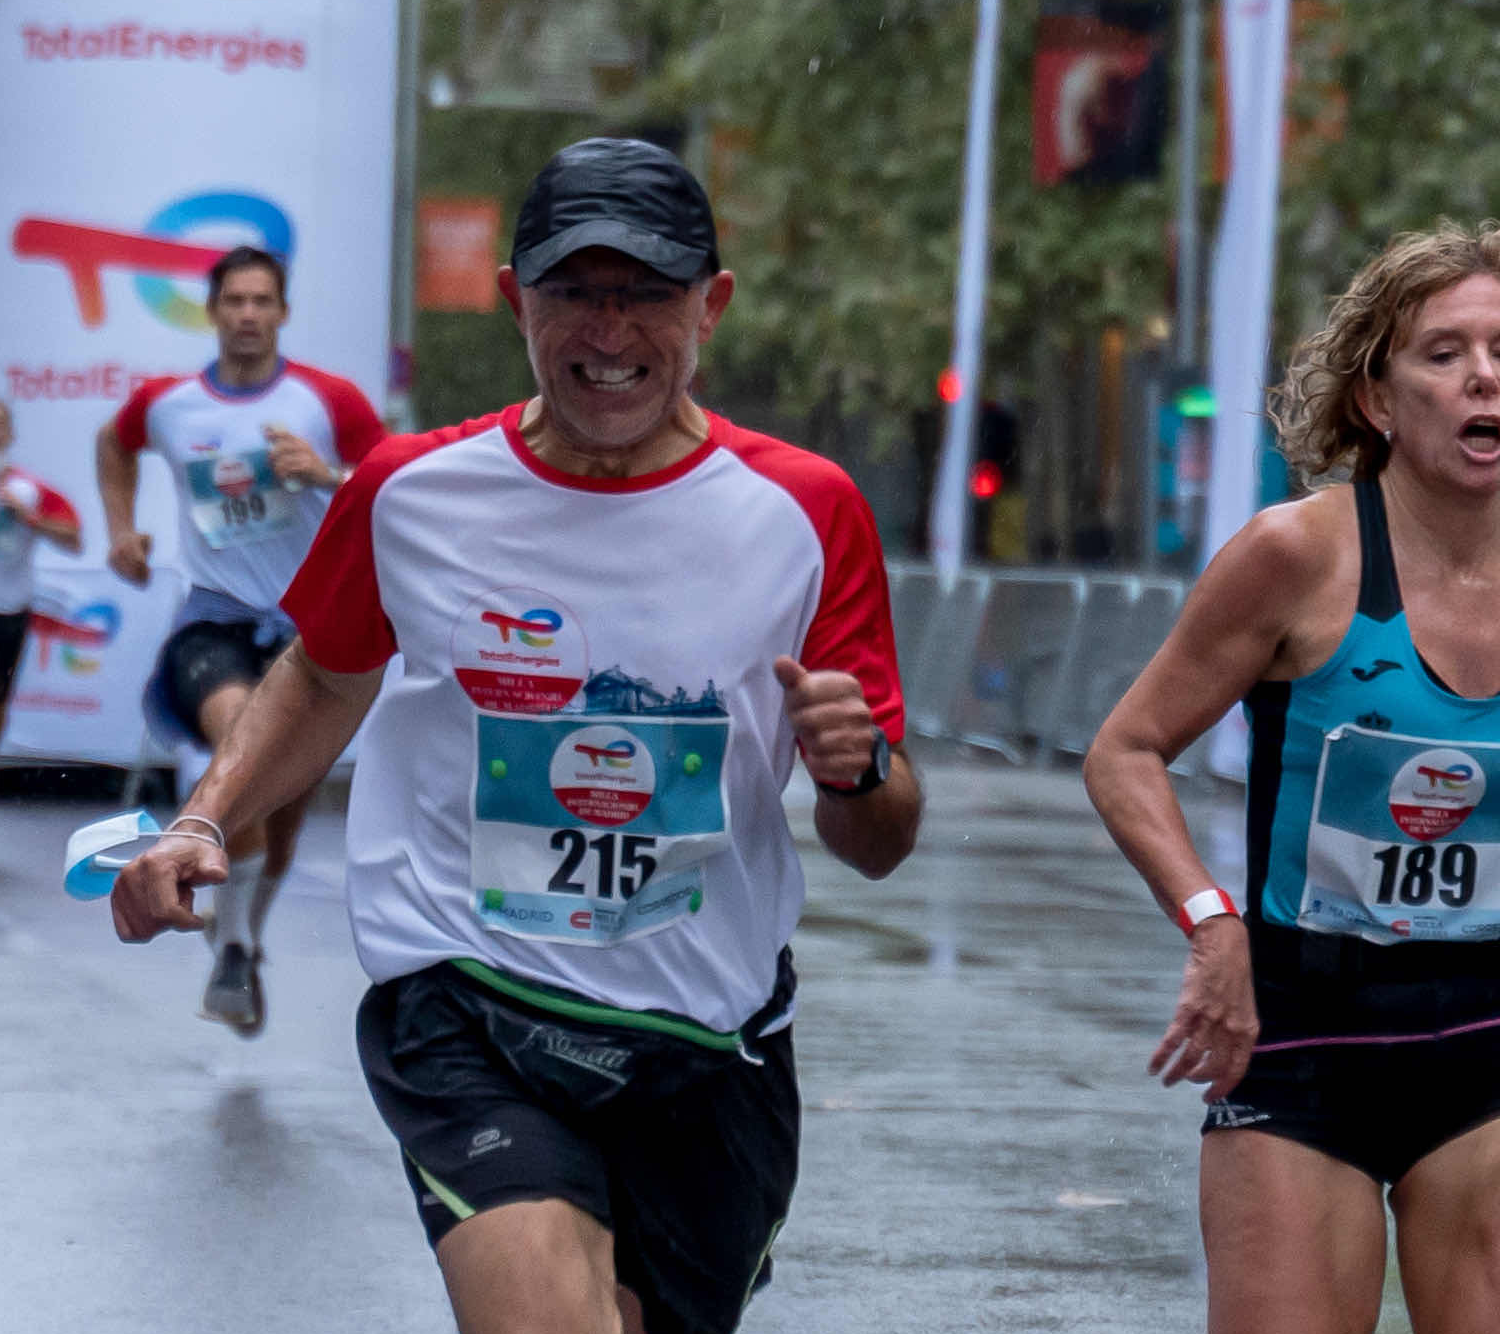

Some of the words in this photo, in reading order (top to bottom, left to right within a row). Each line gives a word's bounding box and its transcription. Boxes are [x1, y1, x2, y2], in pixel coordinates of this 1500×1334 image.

[22, 23, 307, 73] TotalEnergies
[546, 828, 658, 900] 215
[1372, 842, 1477, 908] 189
